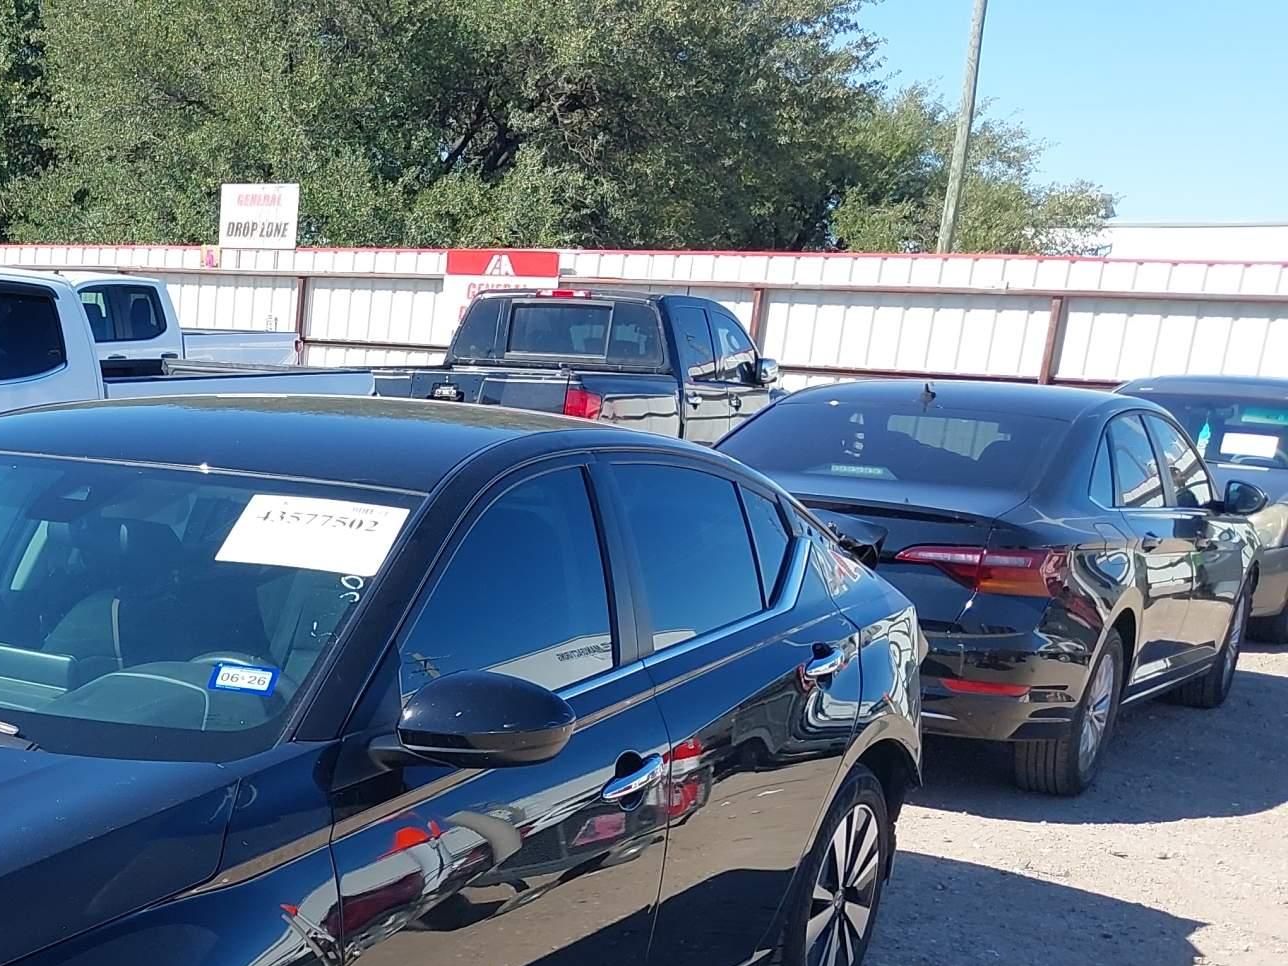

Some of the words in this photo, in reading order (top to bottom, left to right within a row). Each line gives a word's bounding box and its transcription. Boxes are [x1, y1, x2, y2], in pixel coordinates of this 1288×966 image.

[237, 194, 281, 206] GENERAL
[226, 221, 258, 238] DROP
[259, 222, 289, 238] ZONE
[256, 510, 379, 532] 43577502
